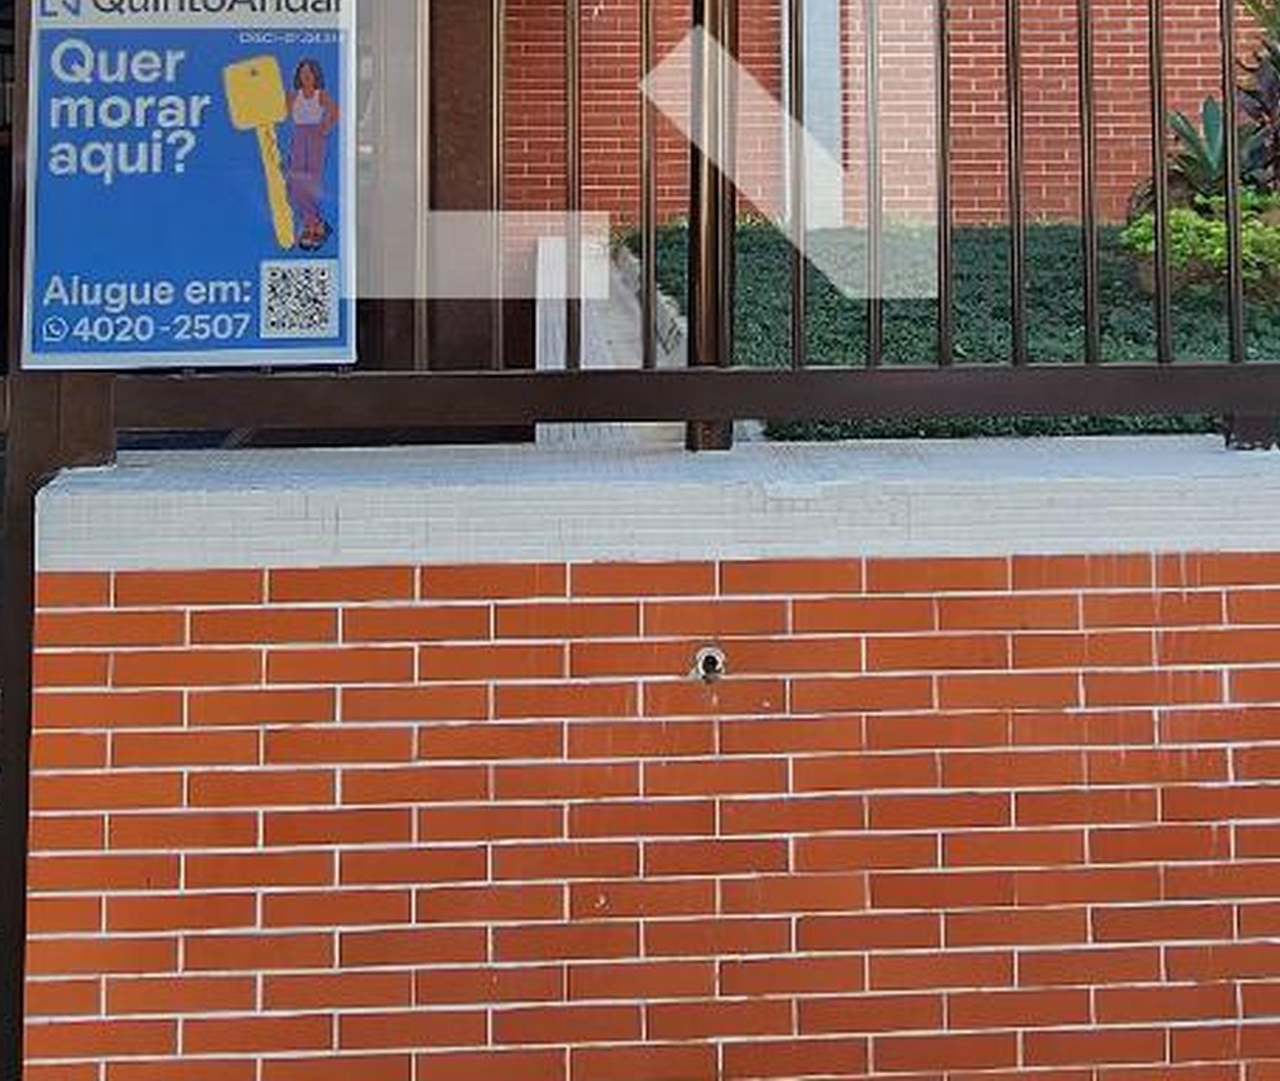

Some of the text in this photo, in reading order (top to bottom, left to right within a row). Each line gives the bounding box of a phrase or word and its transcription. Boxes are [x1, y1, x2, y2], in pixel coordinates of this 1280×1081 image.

[50, 39, 185, 83] Quer
[49, 92, 210, 129] morar
[48, 130, 197, 185] aqui?
[43, 275, 251, 311] Alugue em:
